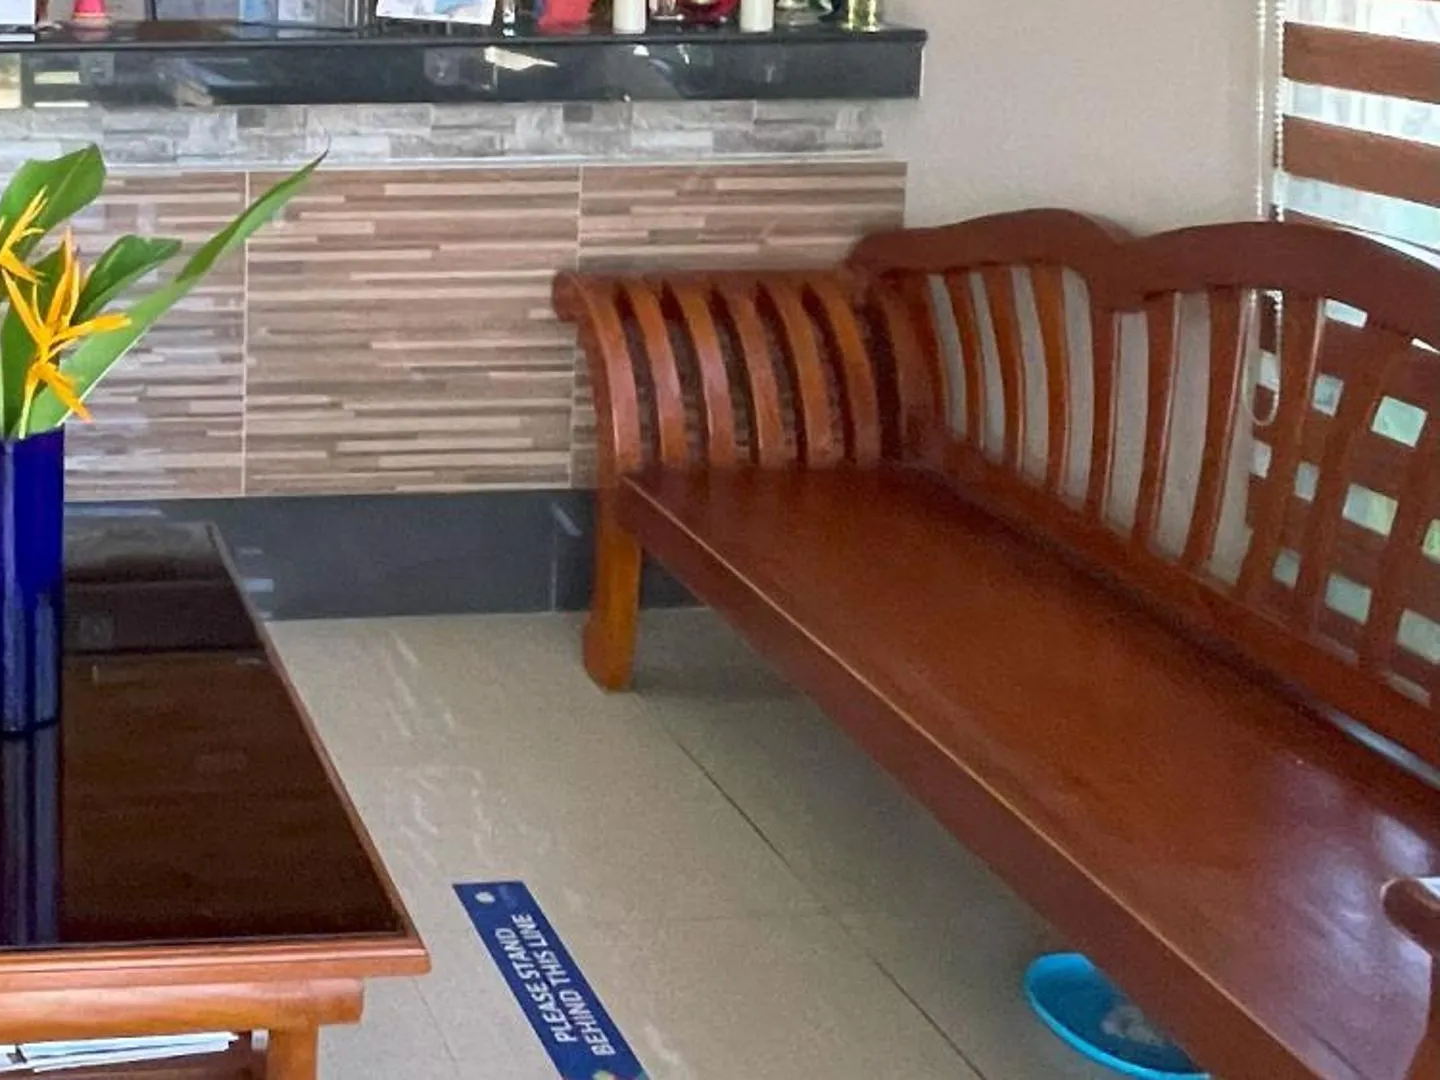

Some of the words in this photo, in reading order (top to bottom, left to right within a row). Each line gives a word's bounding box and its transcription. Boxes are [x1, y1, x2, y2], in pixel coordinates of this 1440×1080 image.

[494, 927, 540, 979] STAND
[511, 913, 548, 947] LINE
[532, 950, 571, 986] THIS
[524, 982, 578, 1042] PLEASE
[559, 990, 616, 1056] BEHIND
